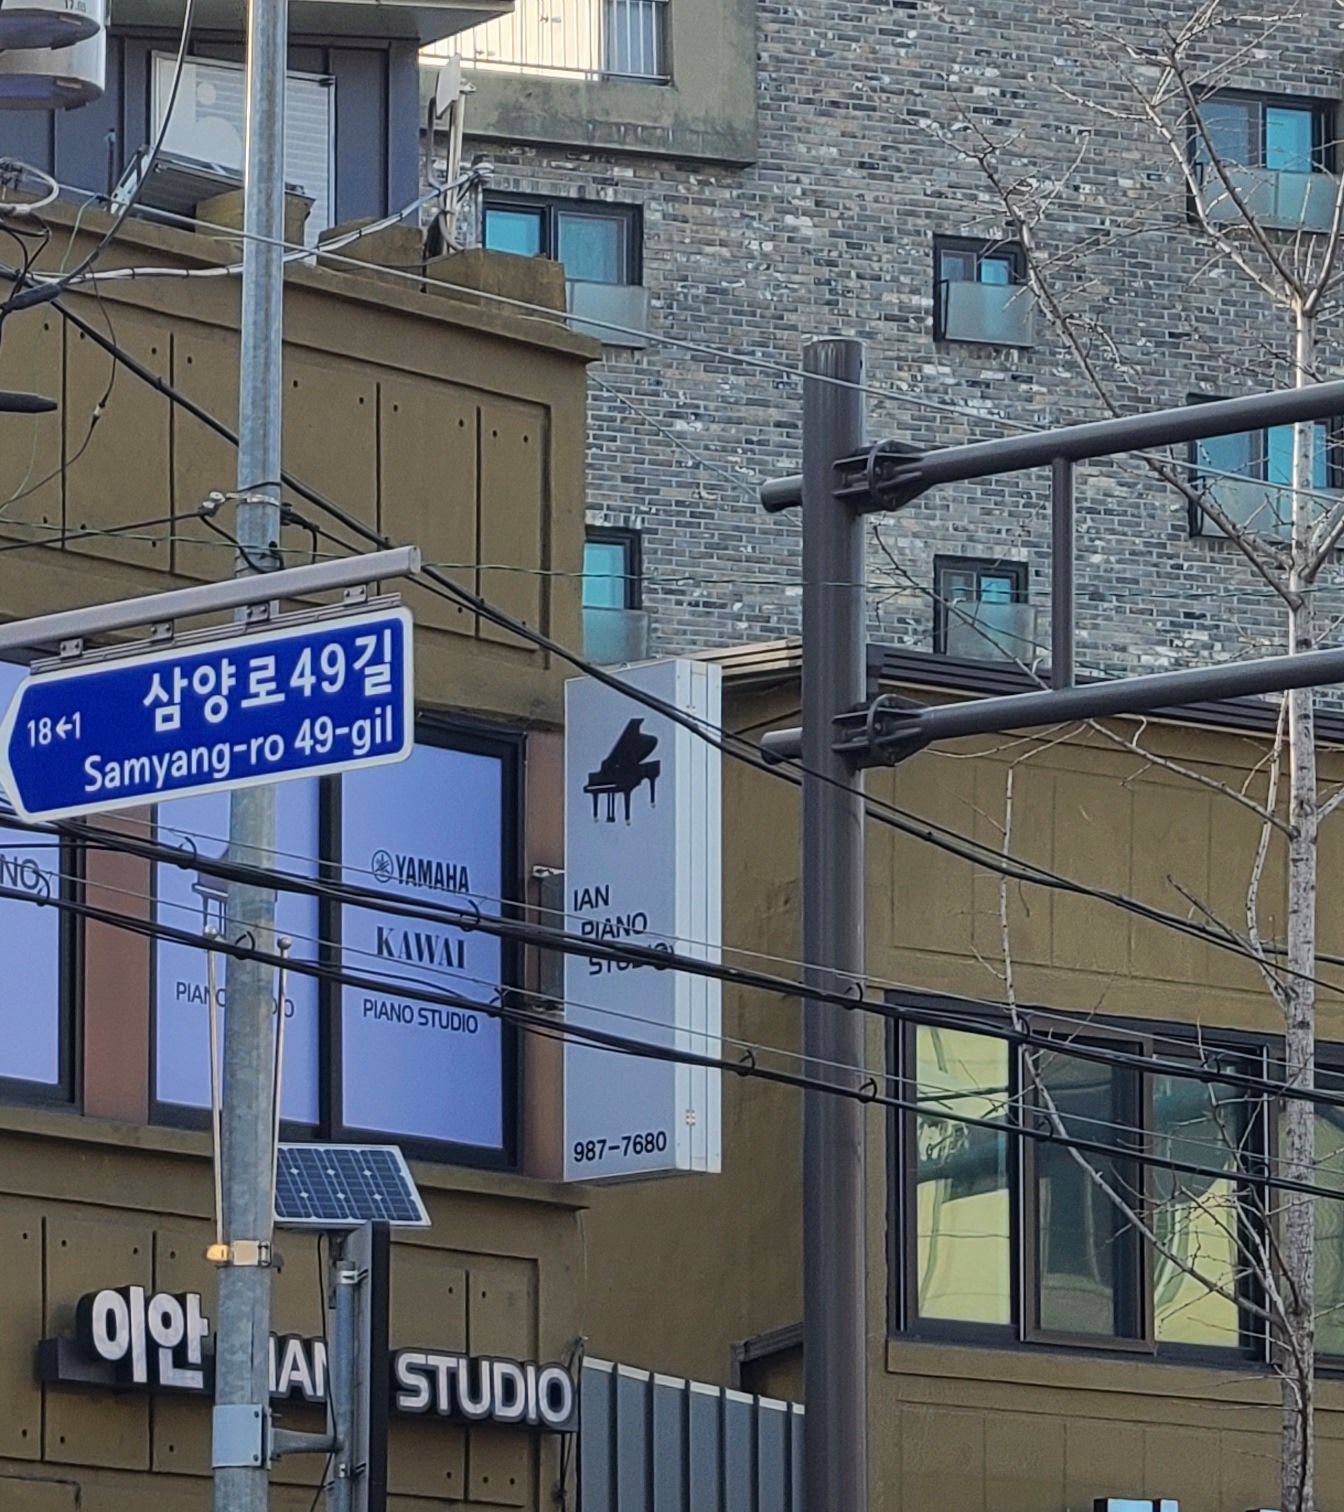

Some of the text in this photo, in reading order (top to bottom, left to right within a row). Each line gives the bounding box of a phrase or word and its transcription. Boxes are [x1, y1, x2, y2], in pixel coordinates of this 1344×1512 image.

[84, 706, 394, 794] Samyang-ro 49-gil
[396, 853, 470, 894] YAMAHA
[574, 884, 609, 912] IAN
[581, 911, 648, 941] PIANO
[376, 925, 466, 970] KAWAI
[363, 998, 479, 1035] PIANO STUDIO
[573, 1130, 667, 1163] 987-7680
[91, 1284, 210, 1390] 이안
[395, 1350, 574, 1423] STUDIO
